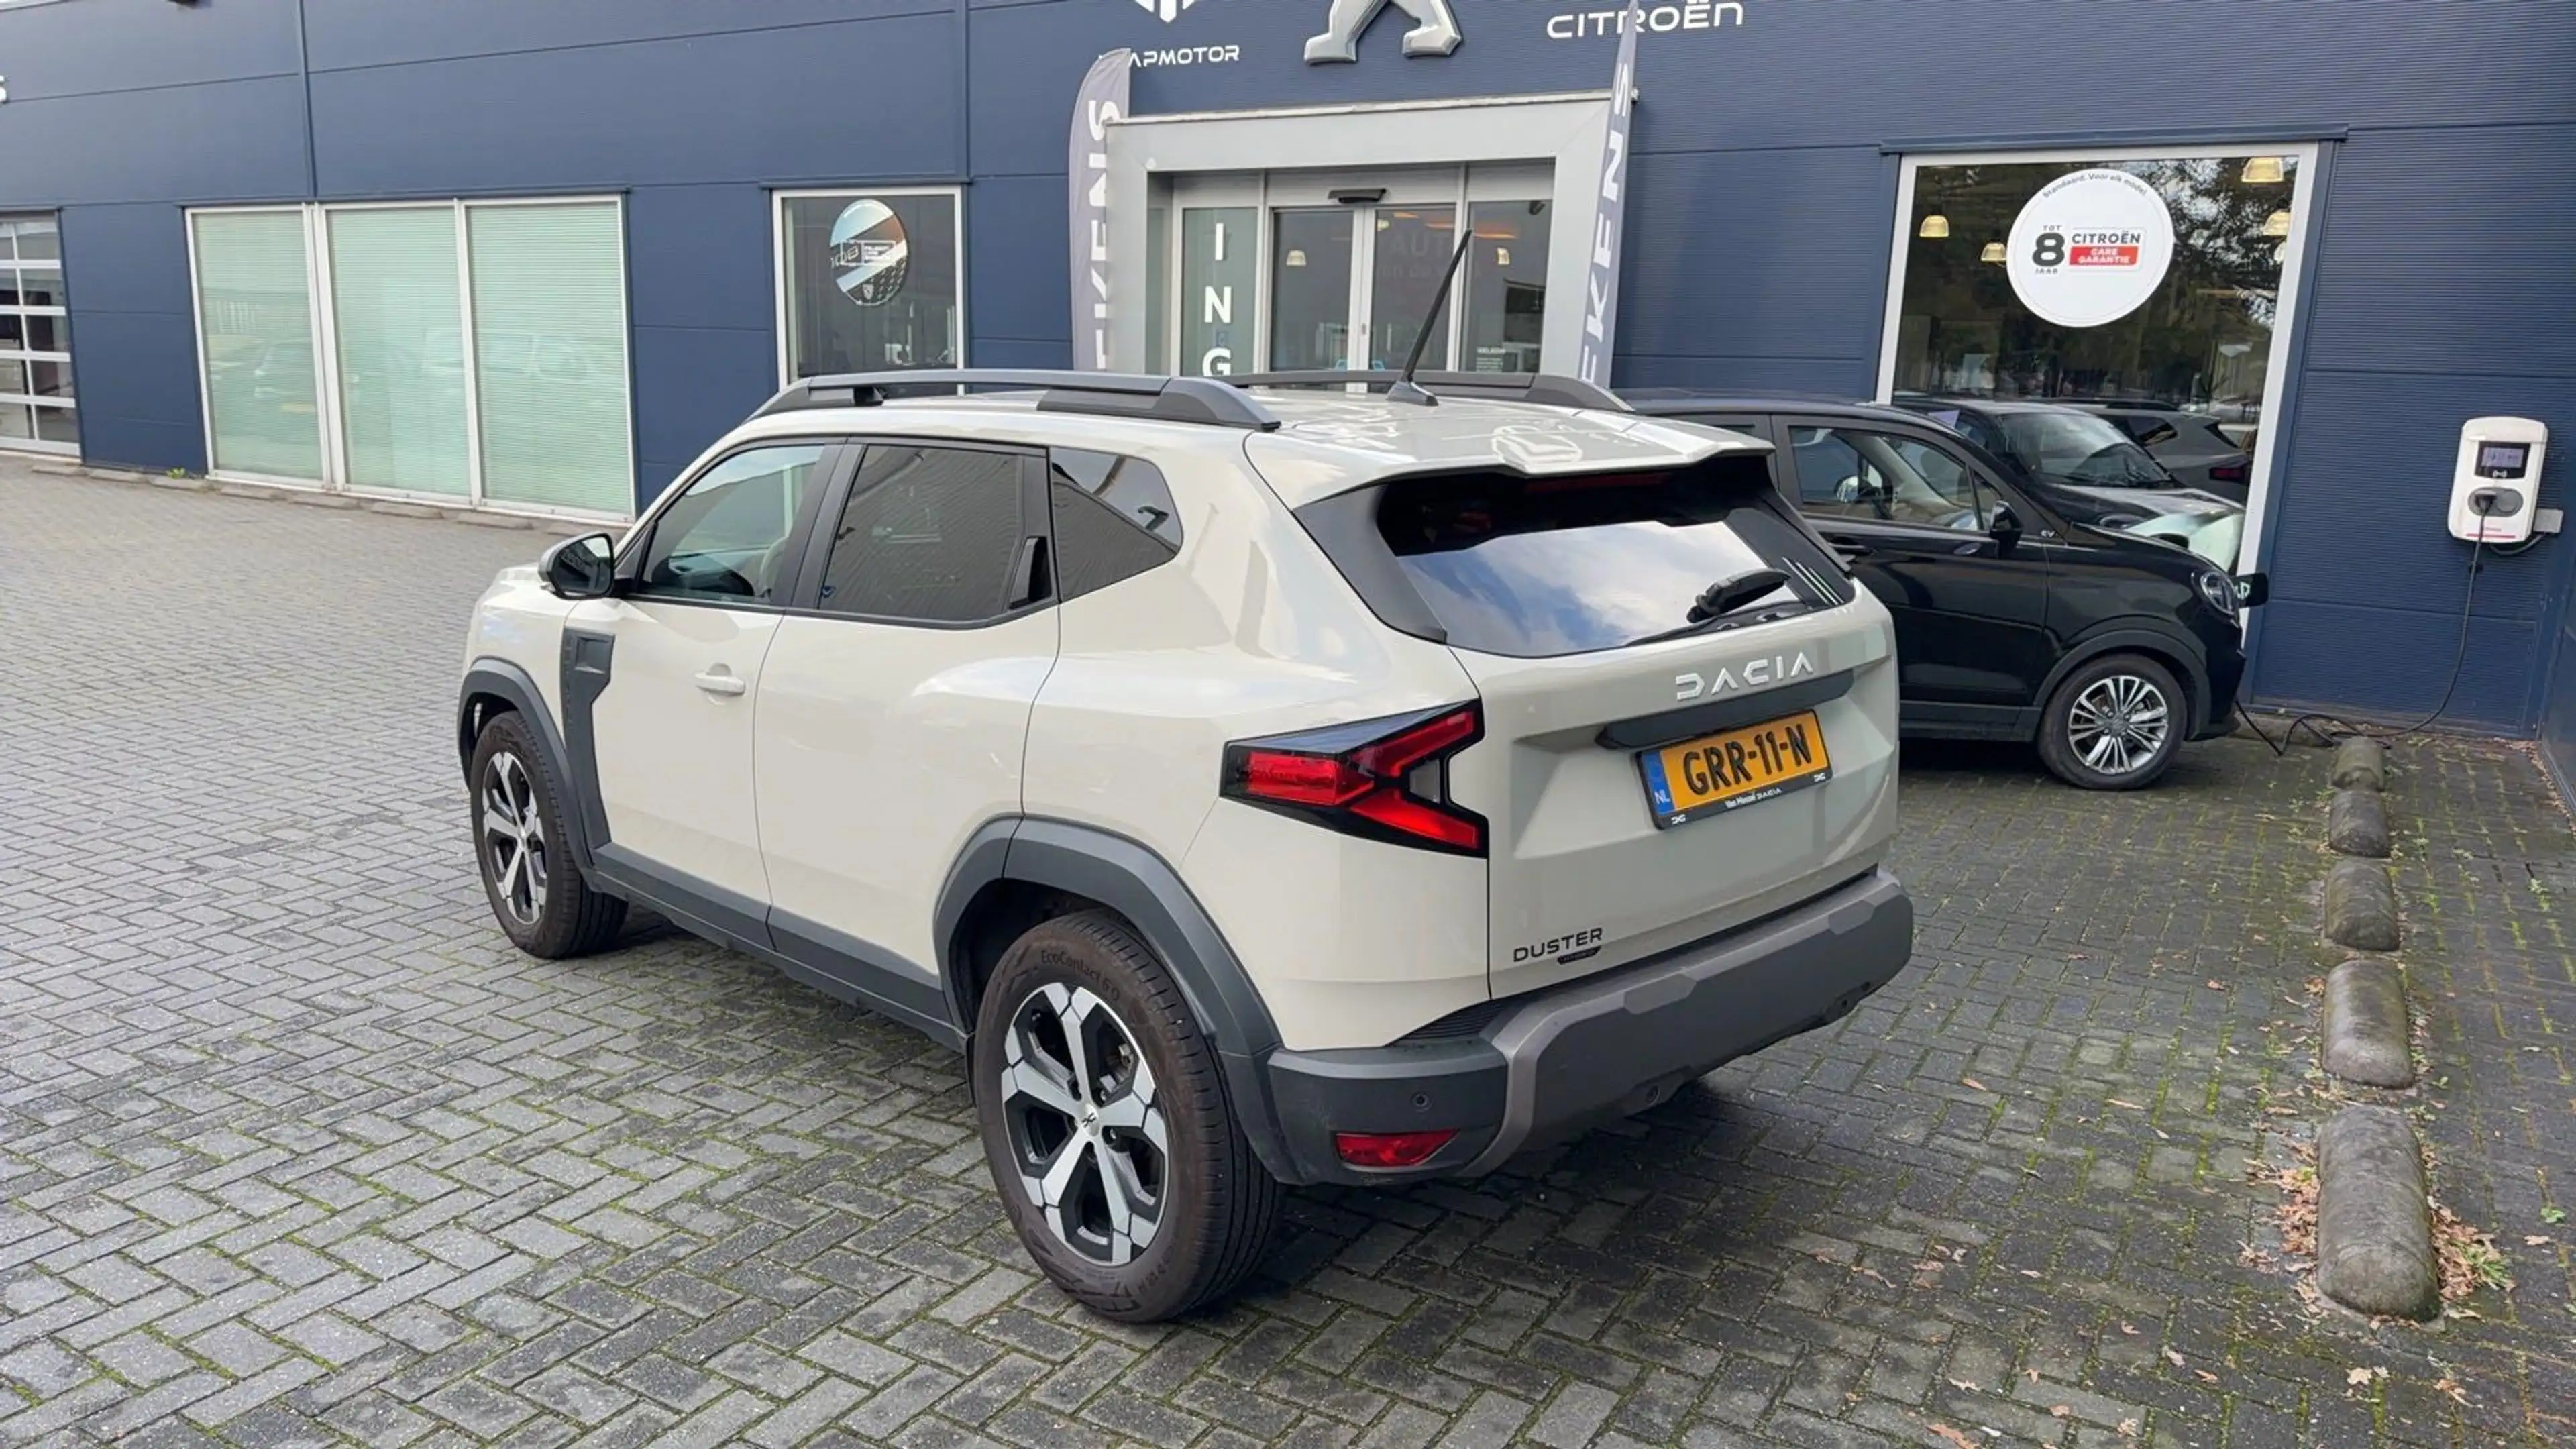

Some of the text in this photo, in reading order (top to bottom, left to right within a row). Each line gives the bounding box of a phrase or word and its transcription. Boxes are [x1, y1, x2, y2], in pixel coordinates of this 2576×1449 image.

[1546, 0, 1743, 38] CITROËN
[1128, 44, 1240, 67] APMOTOR
[2032, 232, 2065, 267] 8
[2072, 230, 2141, 244] CITROËN
[1675, 651, 1814, 701] DACIA
[1682, 723, 1812, 796] GRR-11-N
[1654, 789, 1670, 805] NL
[1756, 788, 1782, 800] DACIA
[1513, 927, 1603, 962] DUSTER
